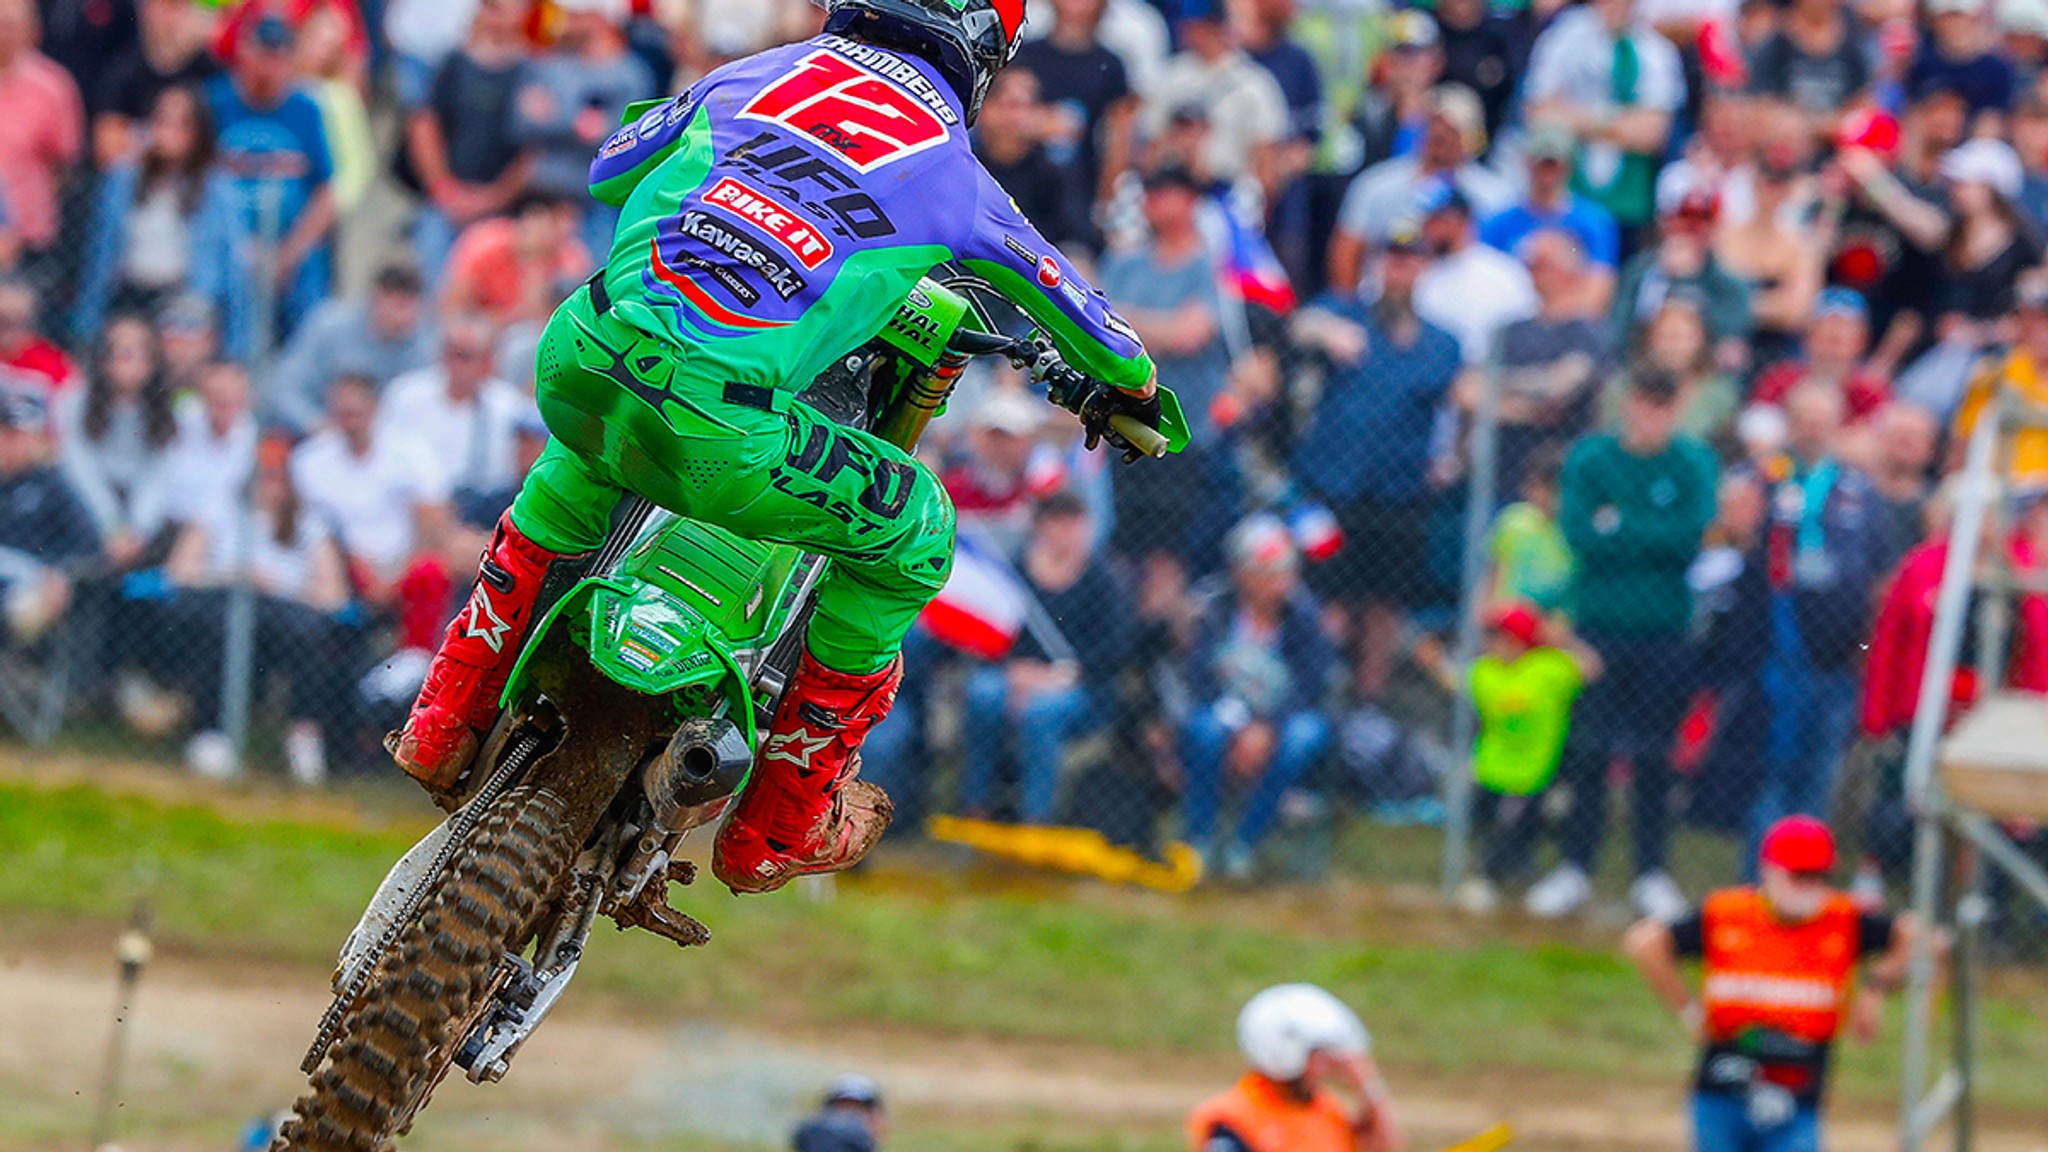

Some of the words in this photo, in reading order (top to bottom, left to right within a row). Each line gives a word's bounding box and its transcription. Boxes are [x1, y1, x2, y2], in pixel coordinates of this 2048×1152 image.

[736, 49, 948, 172] 12
[711, 182, 793, 232] BIKE
[787, 227, 825, 257] IT
[725, 131, 897, 239] UFO
[681, 211, 802, 297] Kawasaki
[770, 466, 883, 536] LAST
